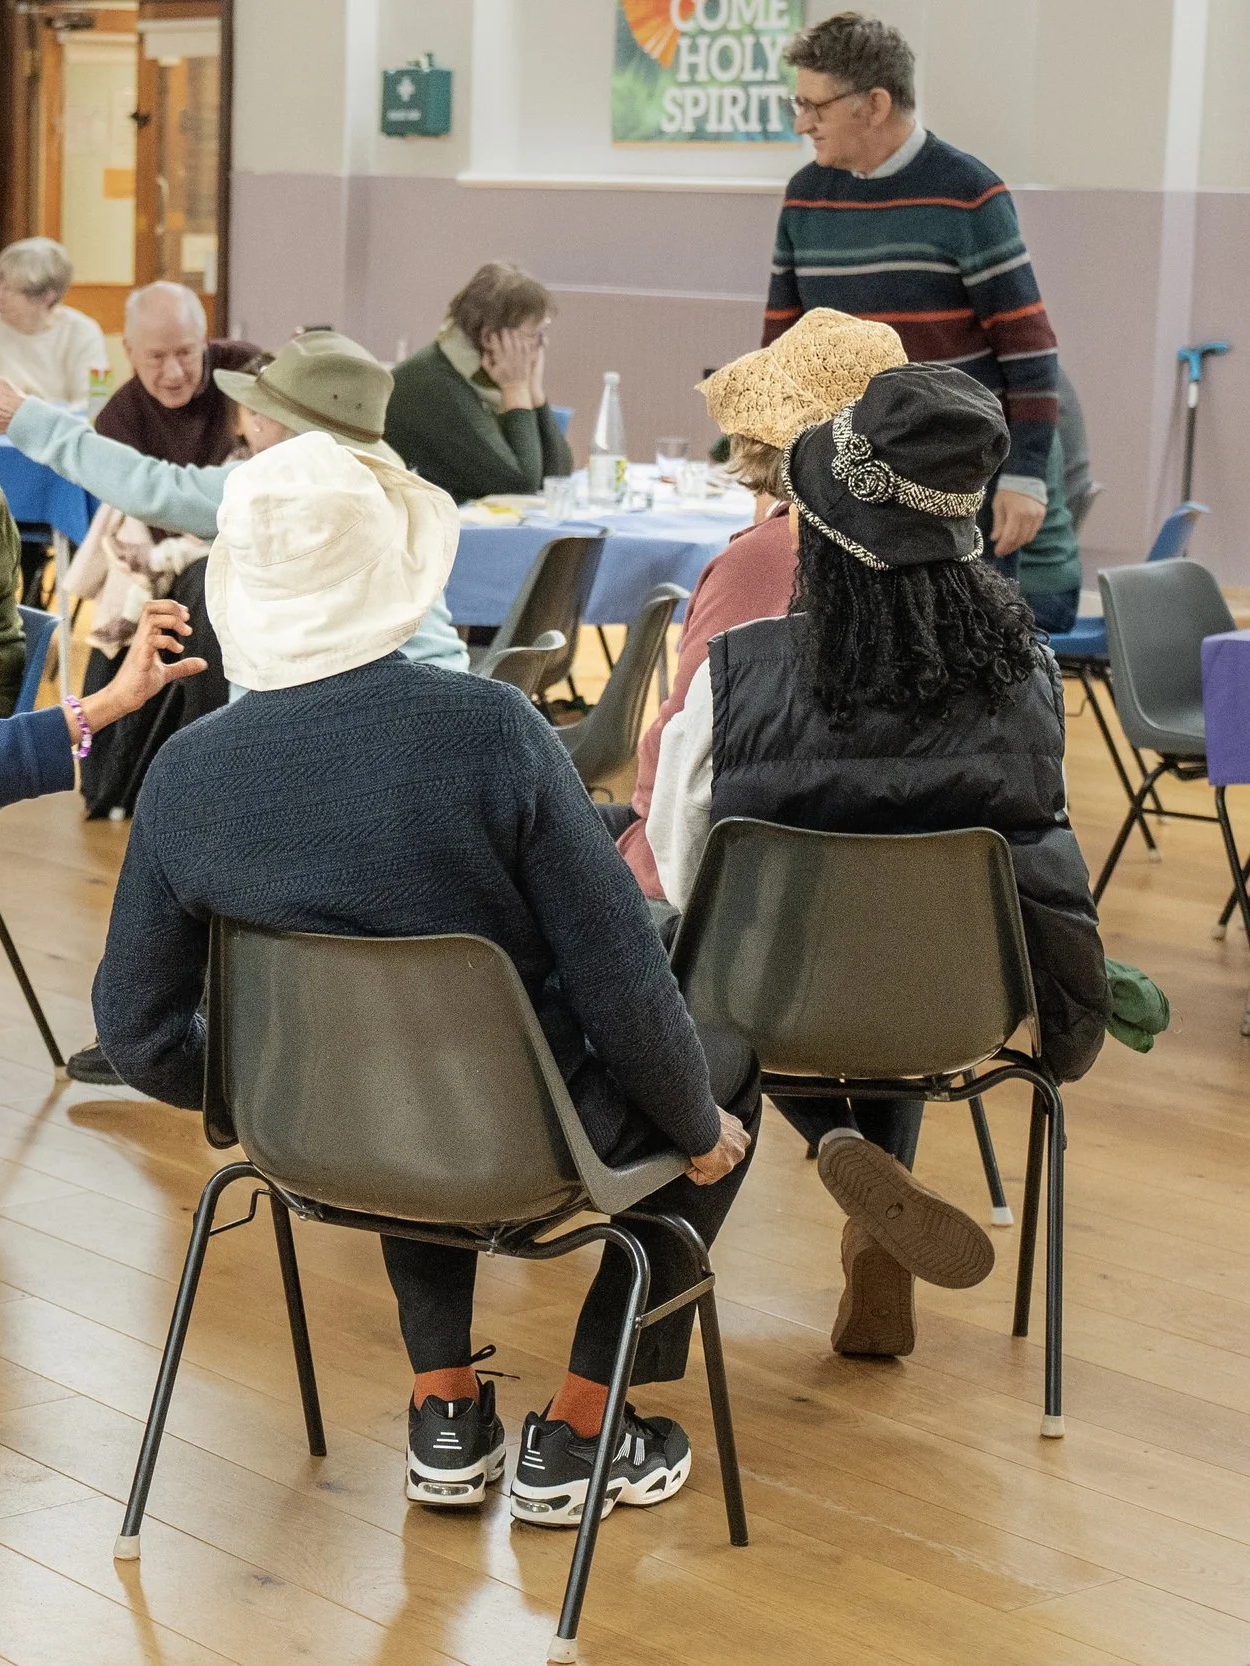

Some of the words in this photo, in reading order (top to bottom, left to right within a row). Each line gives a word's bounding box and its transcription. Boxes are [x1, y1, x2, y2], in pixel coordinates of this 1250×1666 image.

[669, 0, 790, 32] COME
[675, 35, 789, 82] HOLY
[661, 84, 791, 133] SPIRIT
